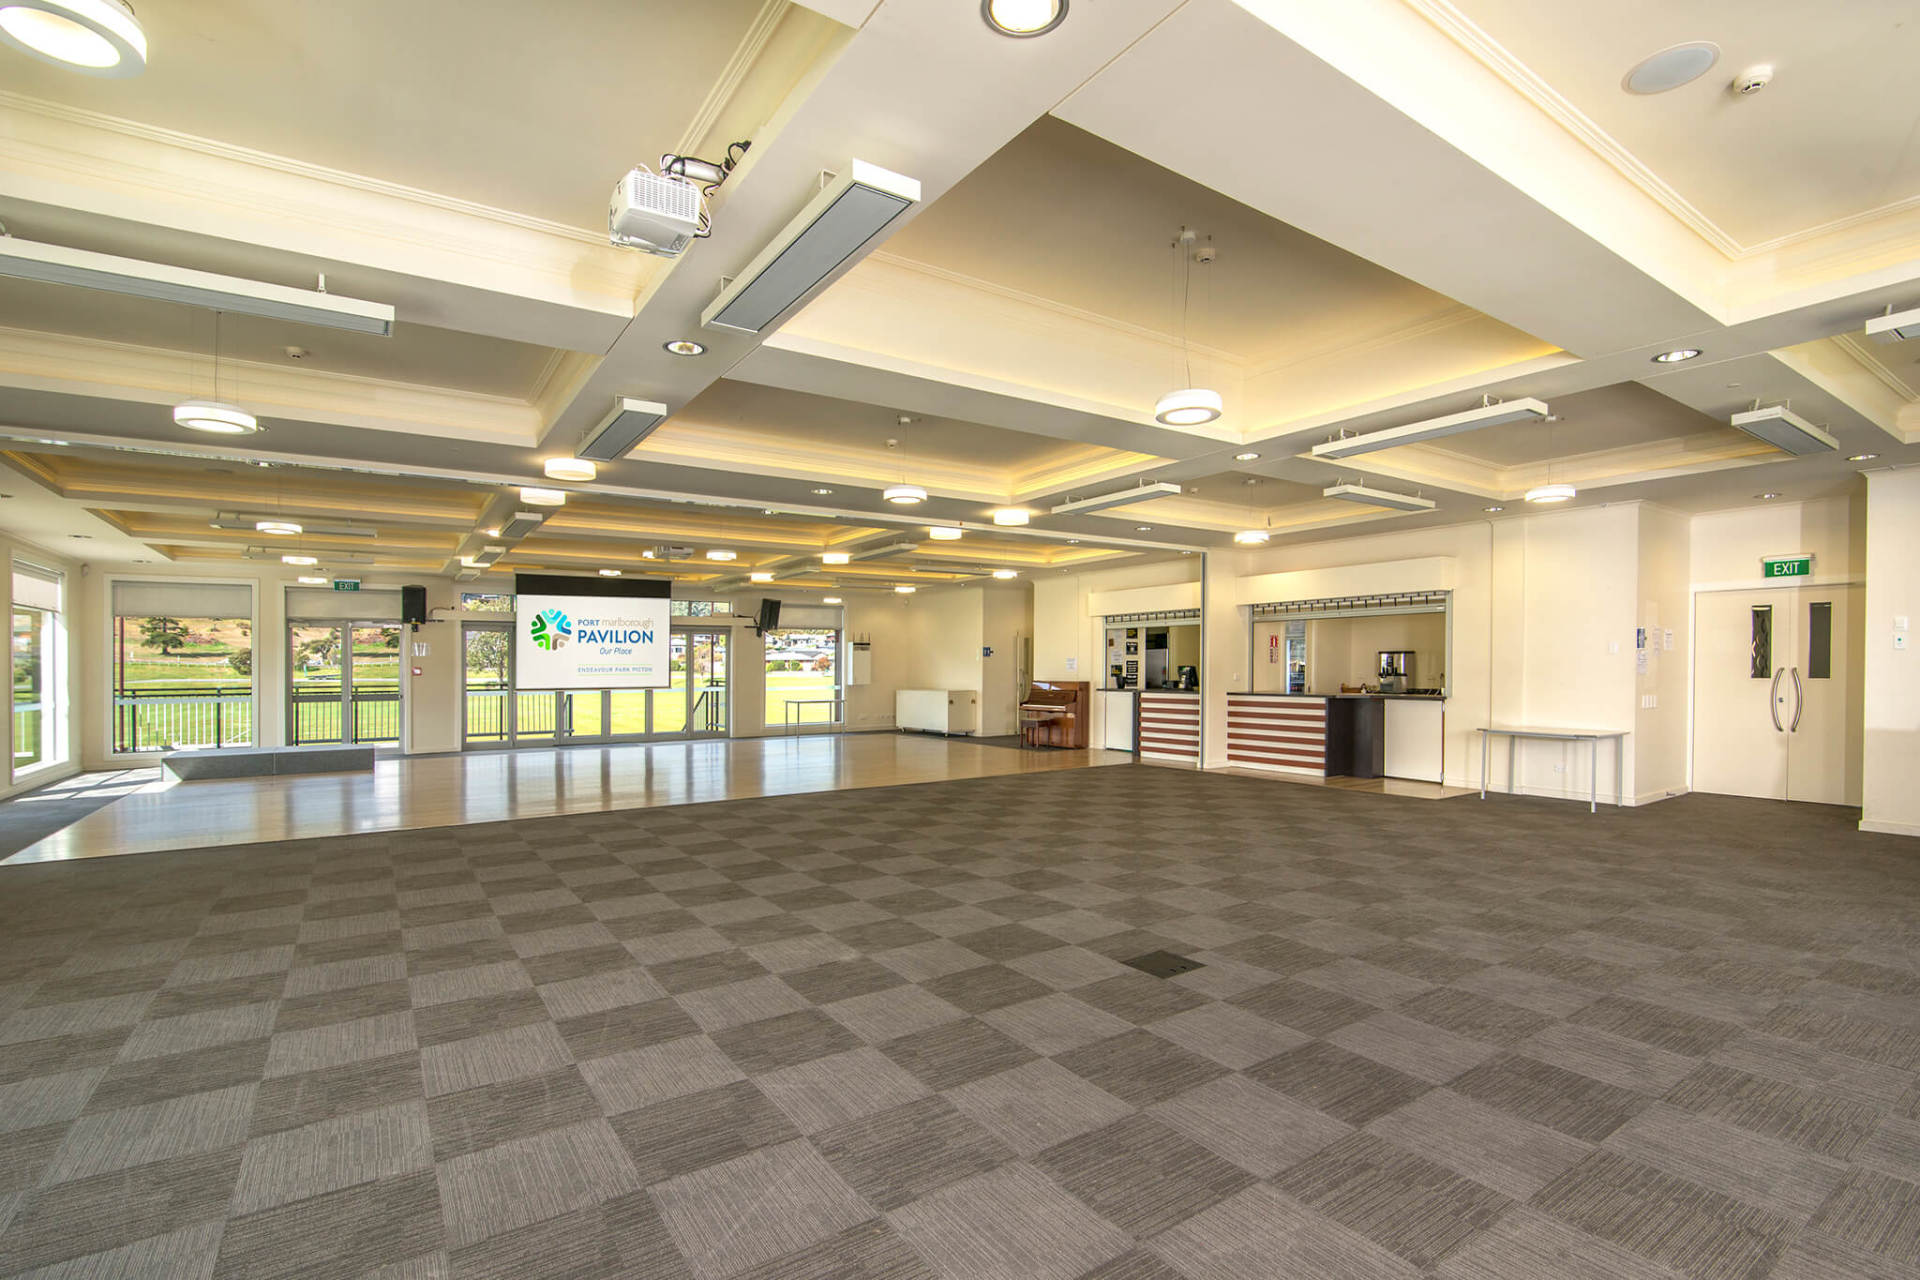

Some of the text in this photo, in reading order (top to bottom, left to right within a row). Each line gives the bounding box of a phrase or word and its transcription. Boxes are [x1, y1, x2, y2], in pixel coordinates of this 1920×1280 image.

[1773, 561, 1801, 576] EXIT
[339, 582, 355, 590] EXIT
[602, 616, 654, 630] marlborough
[577, 629, 654, 644] PAVILION
[600, 647, 633, 655] Our Place
